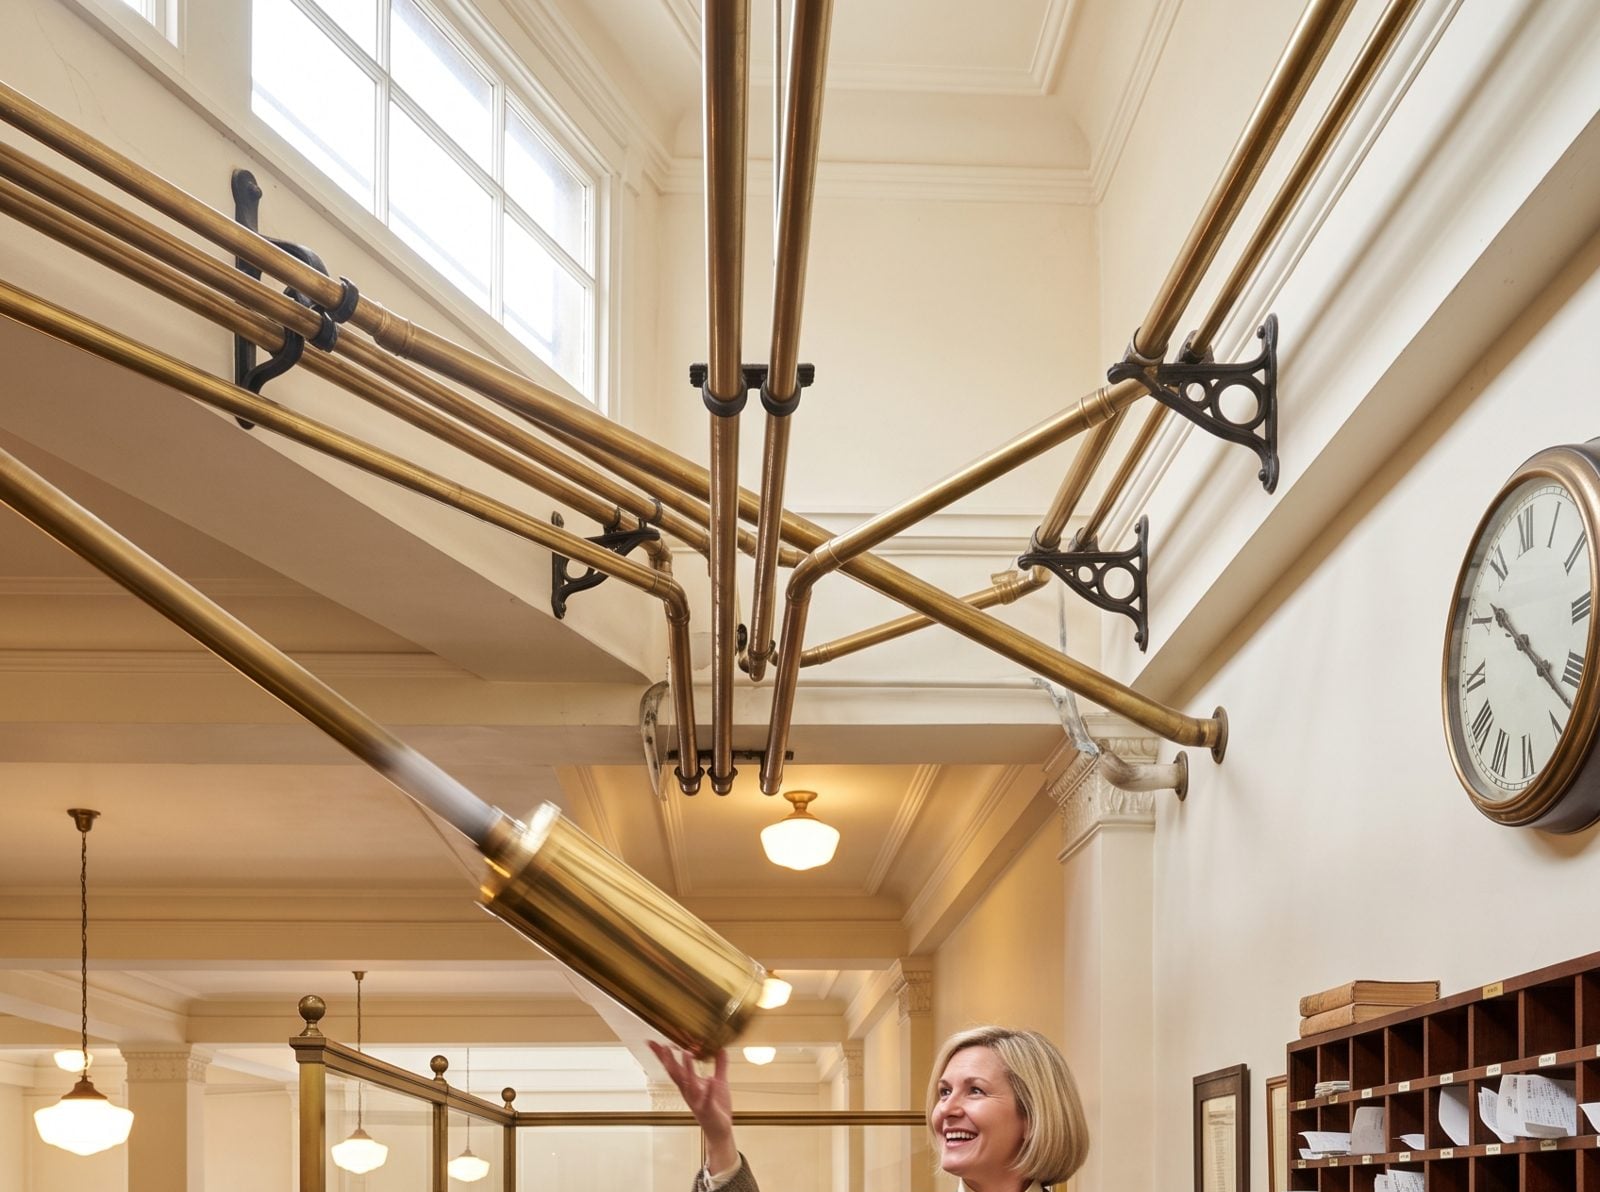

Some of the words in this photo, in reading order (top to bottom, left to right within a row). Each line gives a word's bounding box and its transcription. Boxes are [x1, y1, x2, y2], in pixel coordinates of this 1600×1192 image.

[1517, 504, 1535, 560] XII
[1547, 501, 1562, 548] I
[1489, 544, 1509, 592] XI
[1563, 528, 1587, 576] II
[1472, 609, 1493, 636] X
[1570, 590, 1591, 626] III
[1466, 658, 1486, 694] IX
[1490, 727, 1511, 779] VII
[1520, 732, 1537, 779] VI
